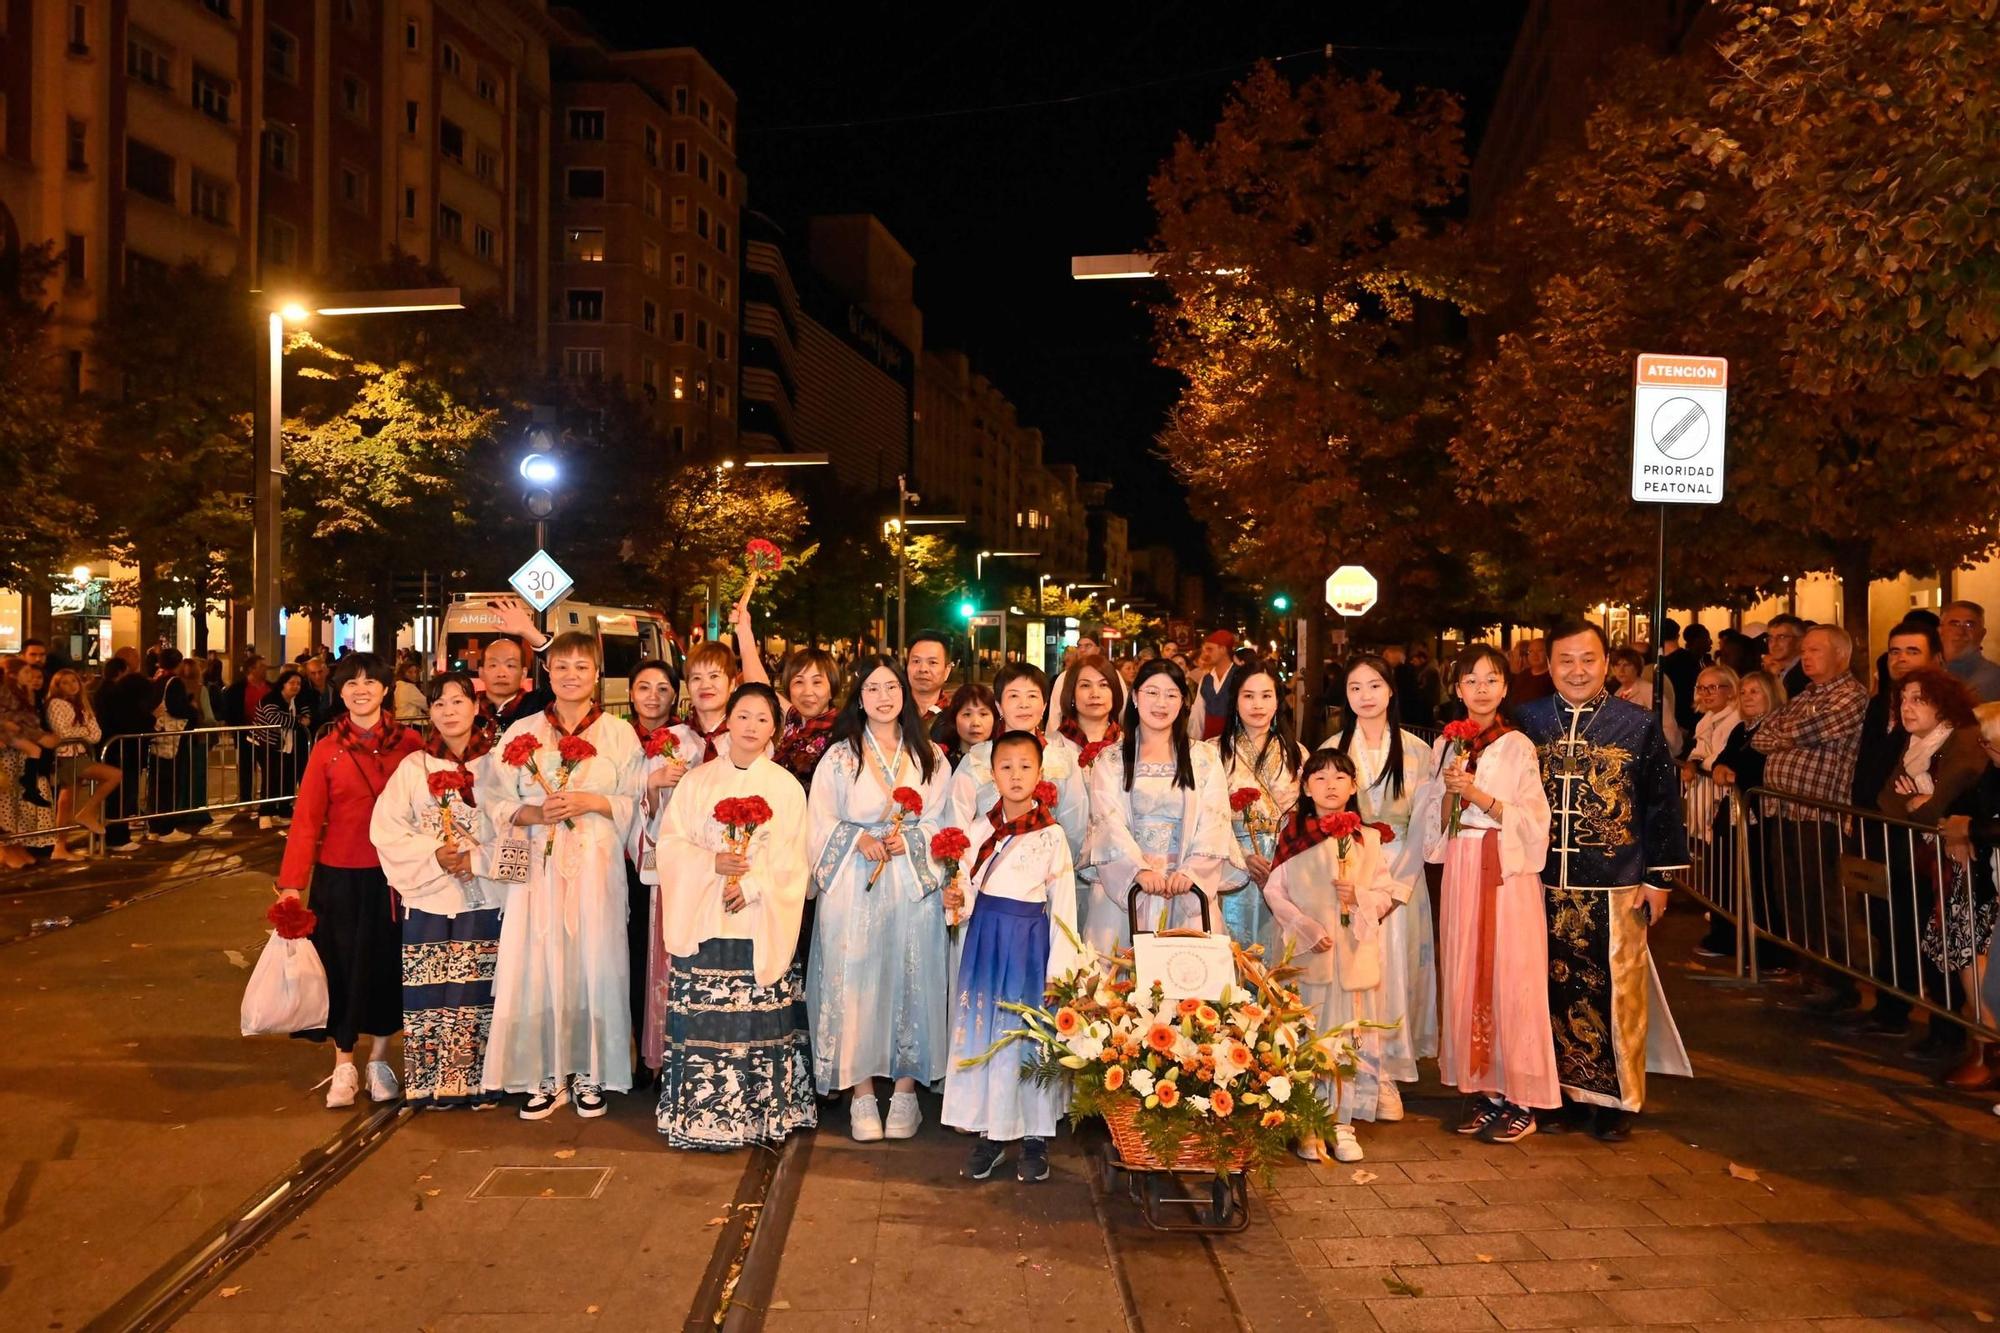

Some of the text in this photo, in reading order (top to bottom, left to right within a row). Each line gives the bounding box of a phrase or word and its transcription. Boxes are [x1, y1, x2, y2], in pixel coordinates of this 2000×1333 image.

[1647, 364, 1717, 378] ATENCIÓN
[1643, 465, 1714, 477] PRIORIDAD
[1644, 482, 1713, 494] PEATONAL
[527, 570, 555, 591] 30
[459, 613, 505, 625] AMBUL
